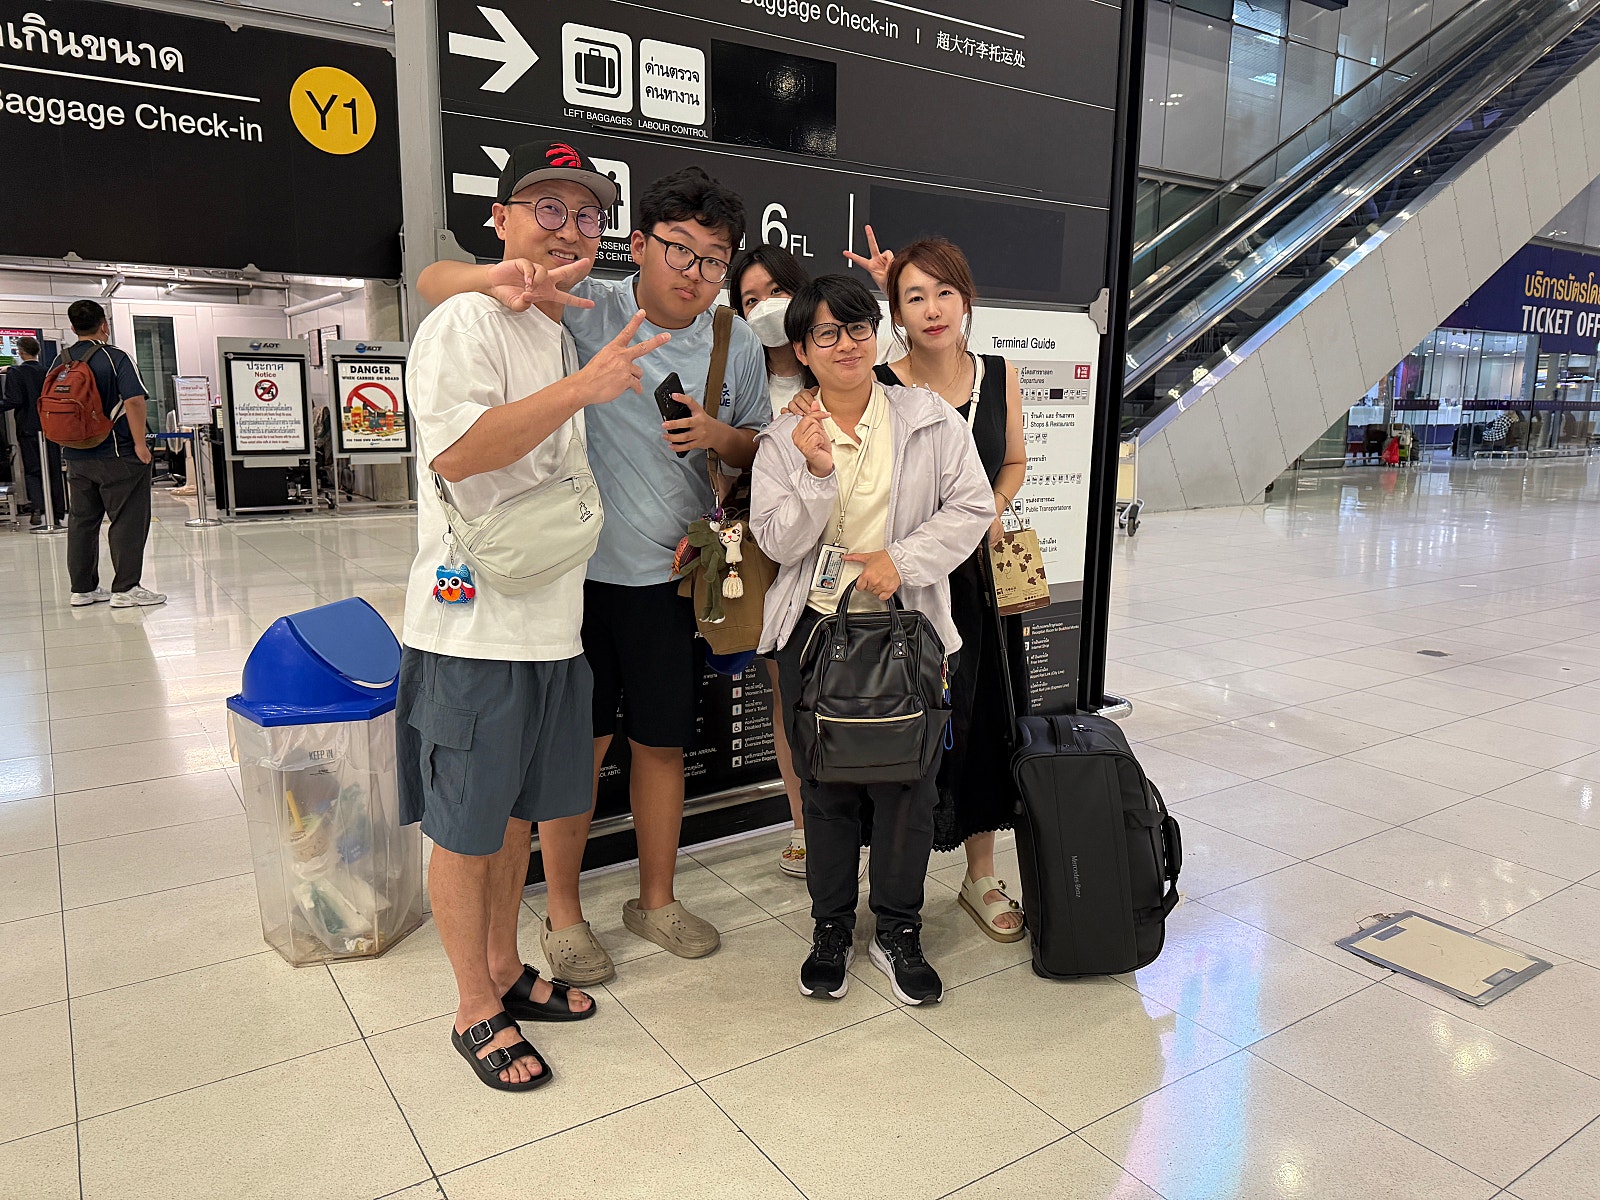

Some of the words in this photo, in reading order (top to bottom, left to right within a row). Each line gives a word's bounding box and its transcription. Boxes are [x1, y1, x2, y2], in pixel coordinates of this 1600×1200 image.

[826, 4, 899, 39] Check-in
[0, 12, 184, 73] เกินขนาด
[936, 31, 1027, 69] 超大行李托运处
[645, 56, 700, 84] ด่านตรวจ
[645, 84, 700, 106] คนหางาน
[135, 103, 263, 142] Check-in
[305, 90, 359, 135] Y1
[564, 108, 584, 119] LEFT
[586, 111, 632, 126] BAGGAGES
[638, 119, 670, 133] LABOUR
[671, 125, 709, 138] CONTROL
[606, 252, 635, 263] CENTE
[1522, 305, 1573, 335] TICKET
[992, 336, 1028, 349] Terminal
[1030, 338, 1056, 349] Guide
[246, 360, 284, 371] ประกาศ
[350, 365, 391, 374] DANGER
[1020, 377, 1045, 385] Departures
